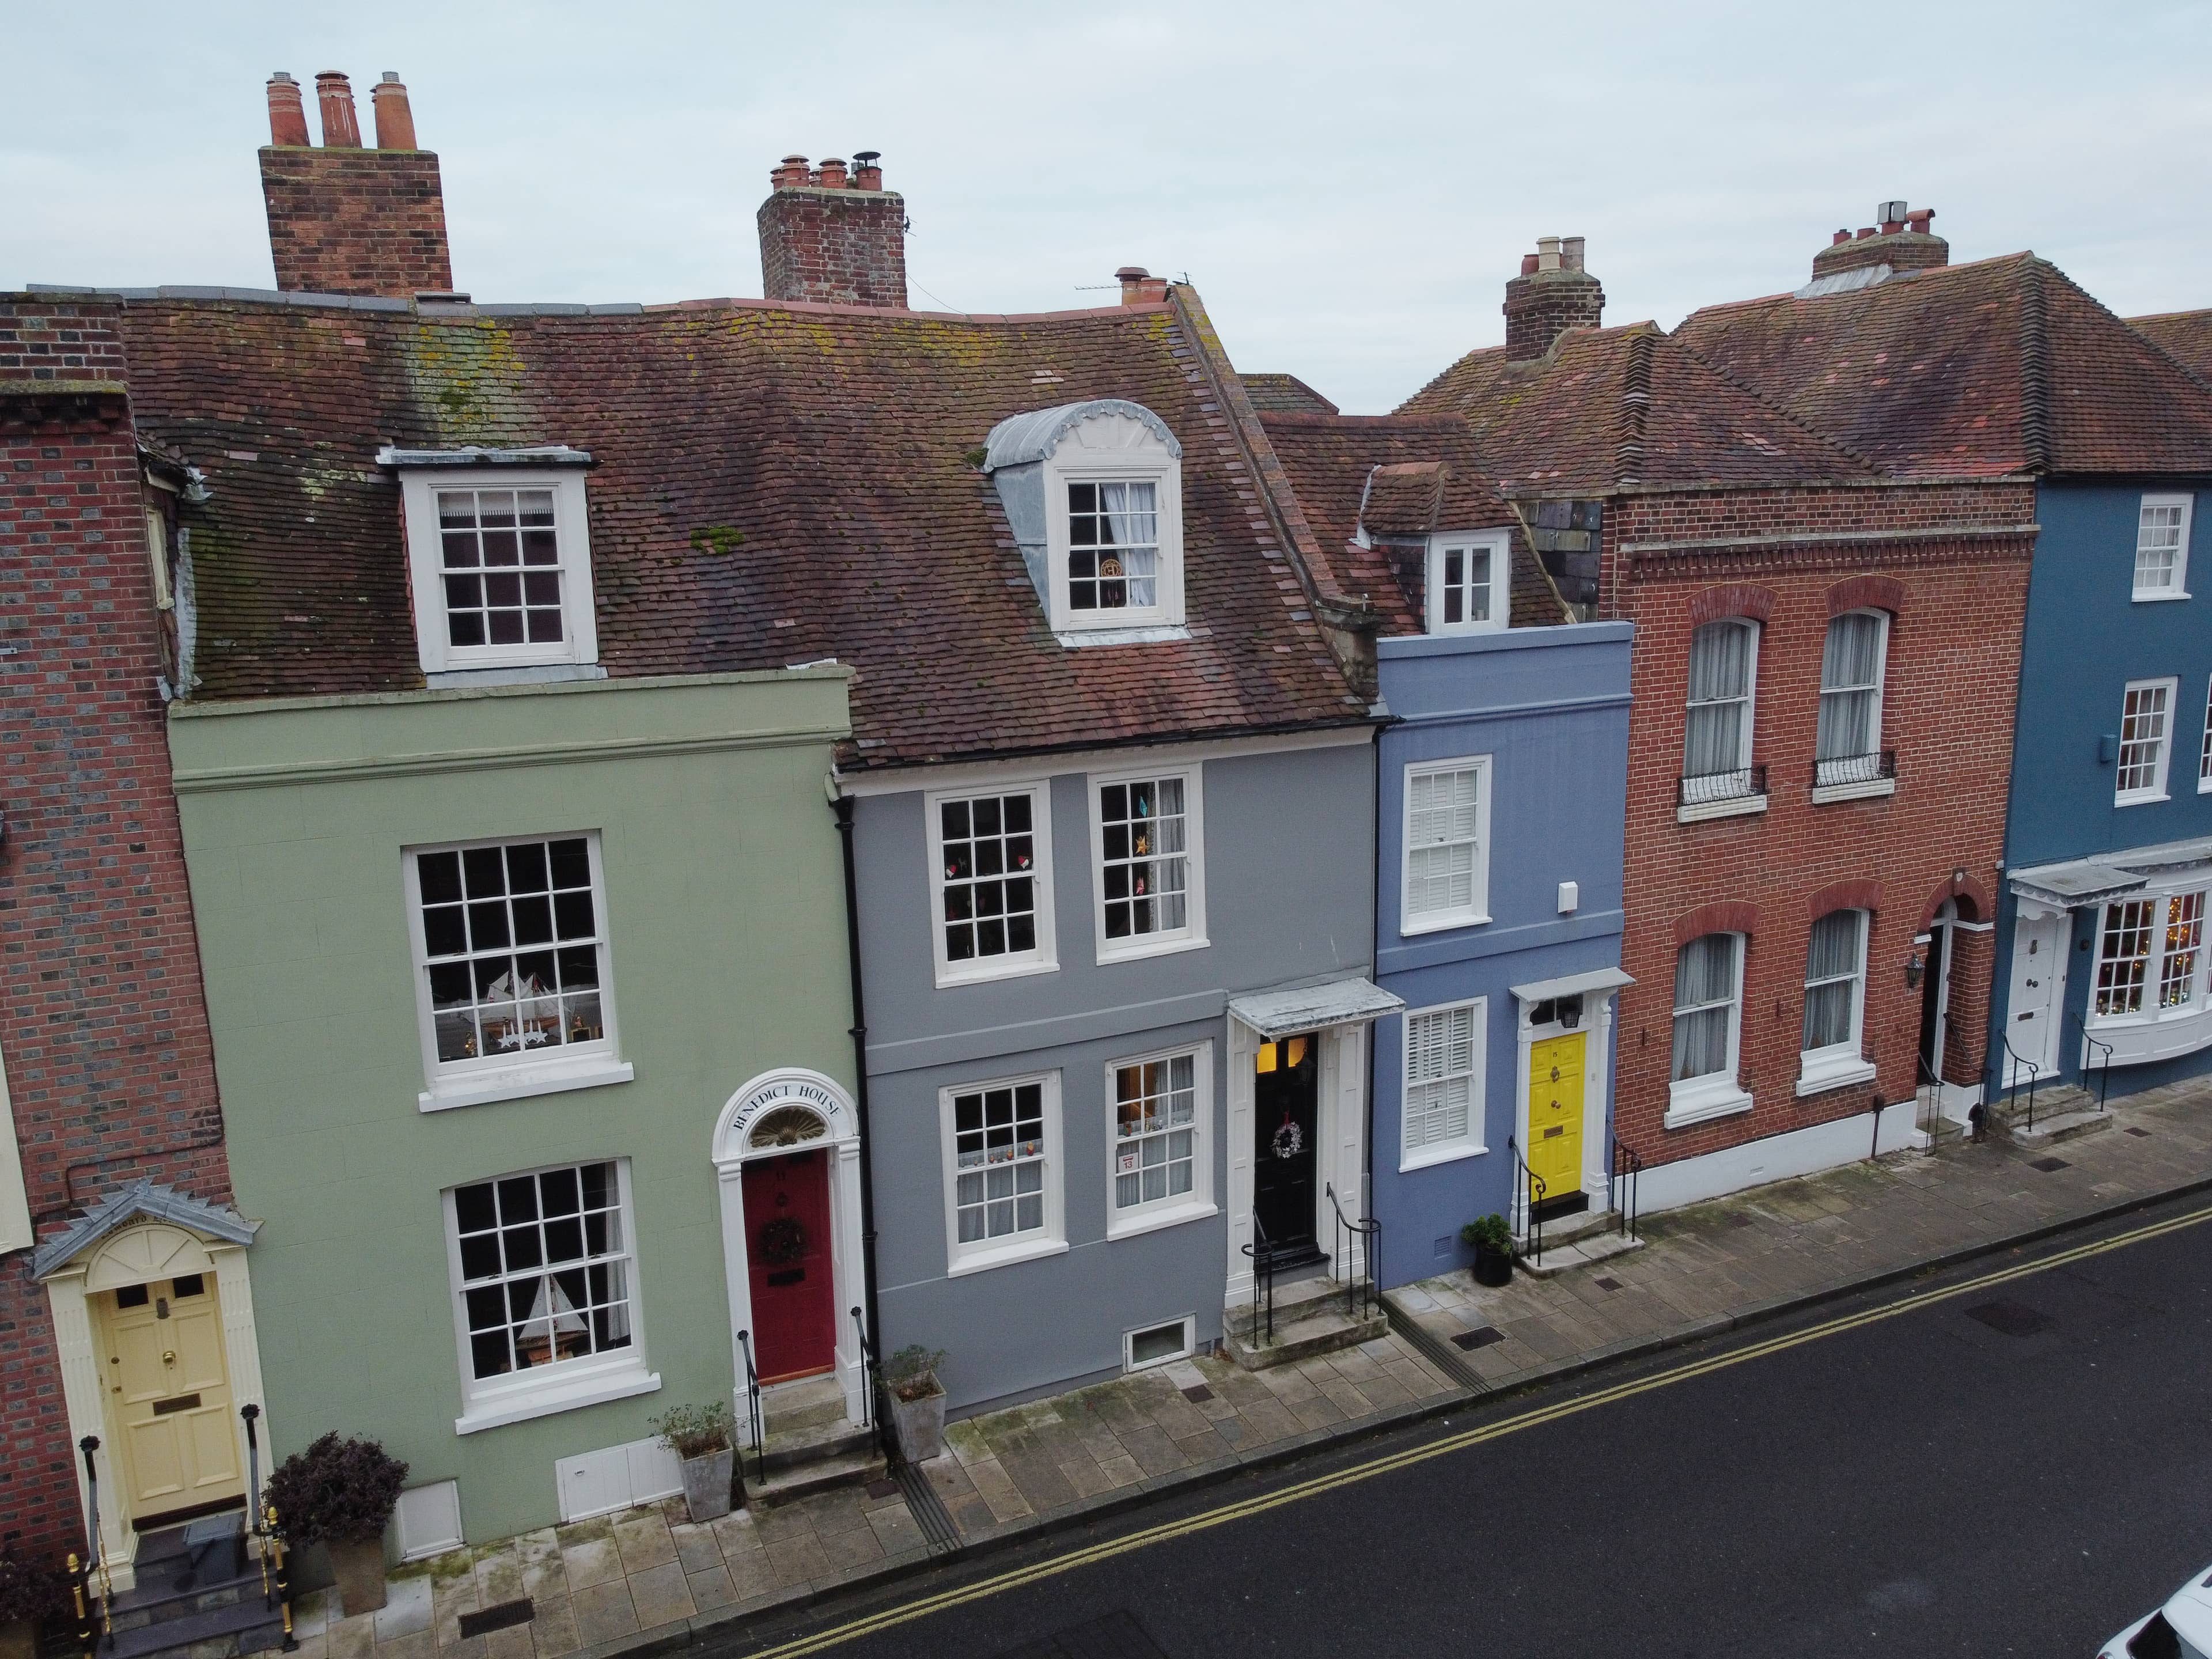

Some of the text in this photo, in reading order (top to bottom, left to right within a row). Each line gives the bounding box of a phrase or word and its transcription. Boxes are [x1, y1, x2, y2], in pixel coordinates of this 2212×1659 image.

[733, 1085, 841, 1130] BENEDICT HOUSE
[1124, 1161, 1132, 1169] 13
